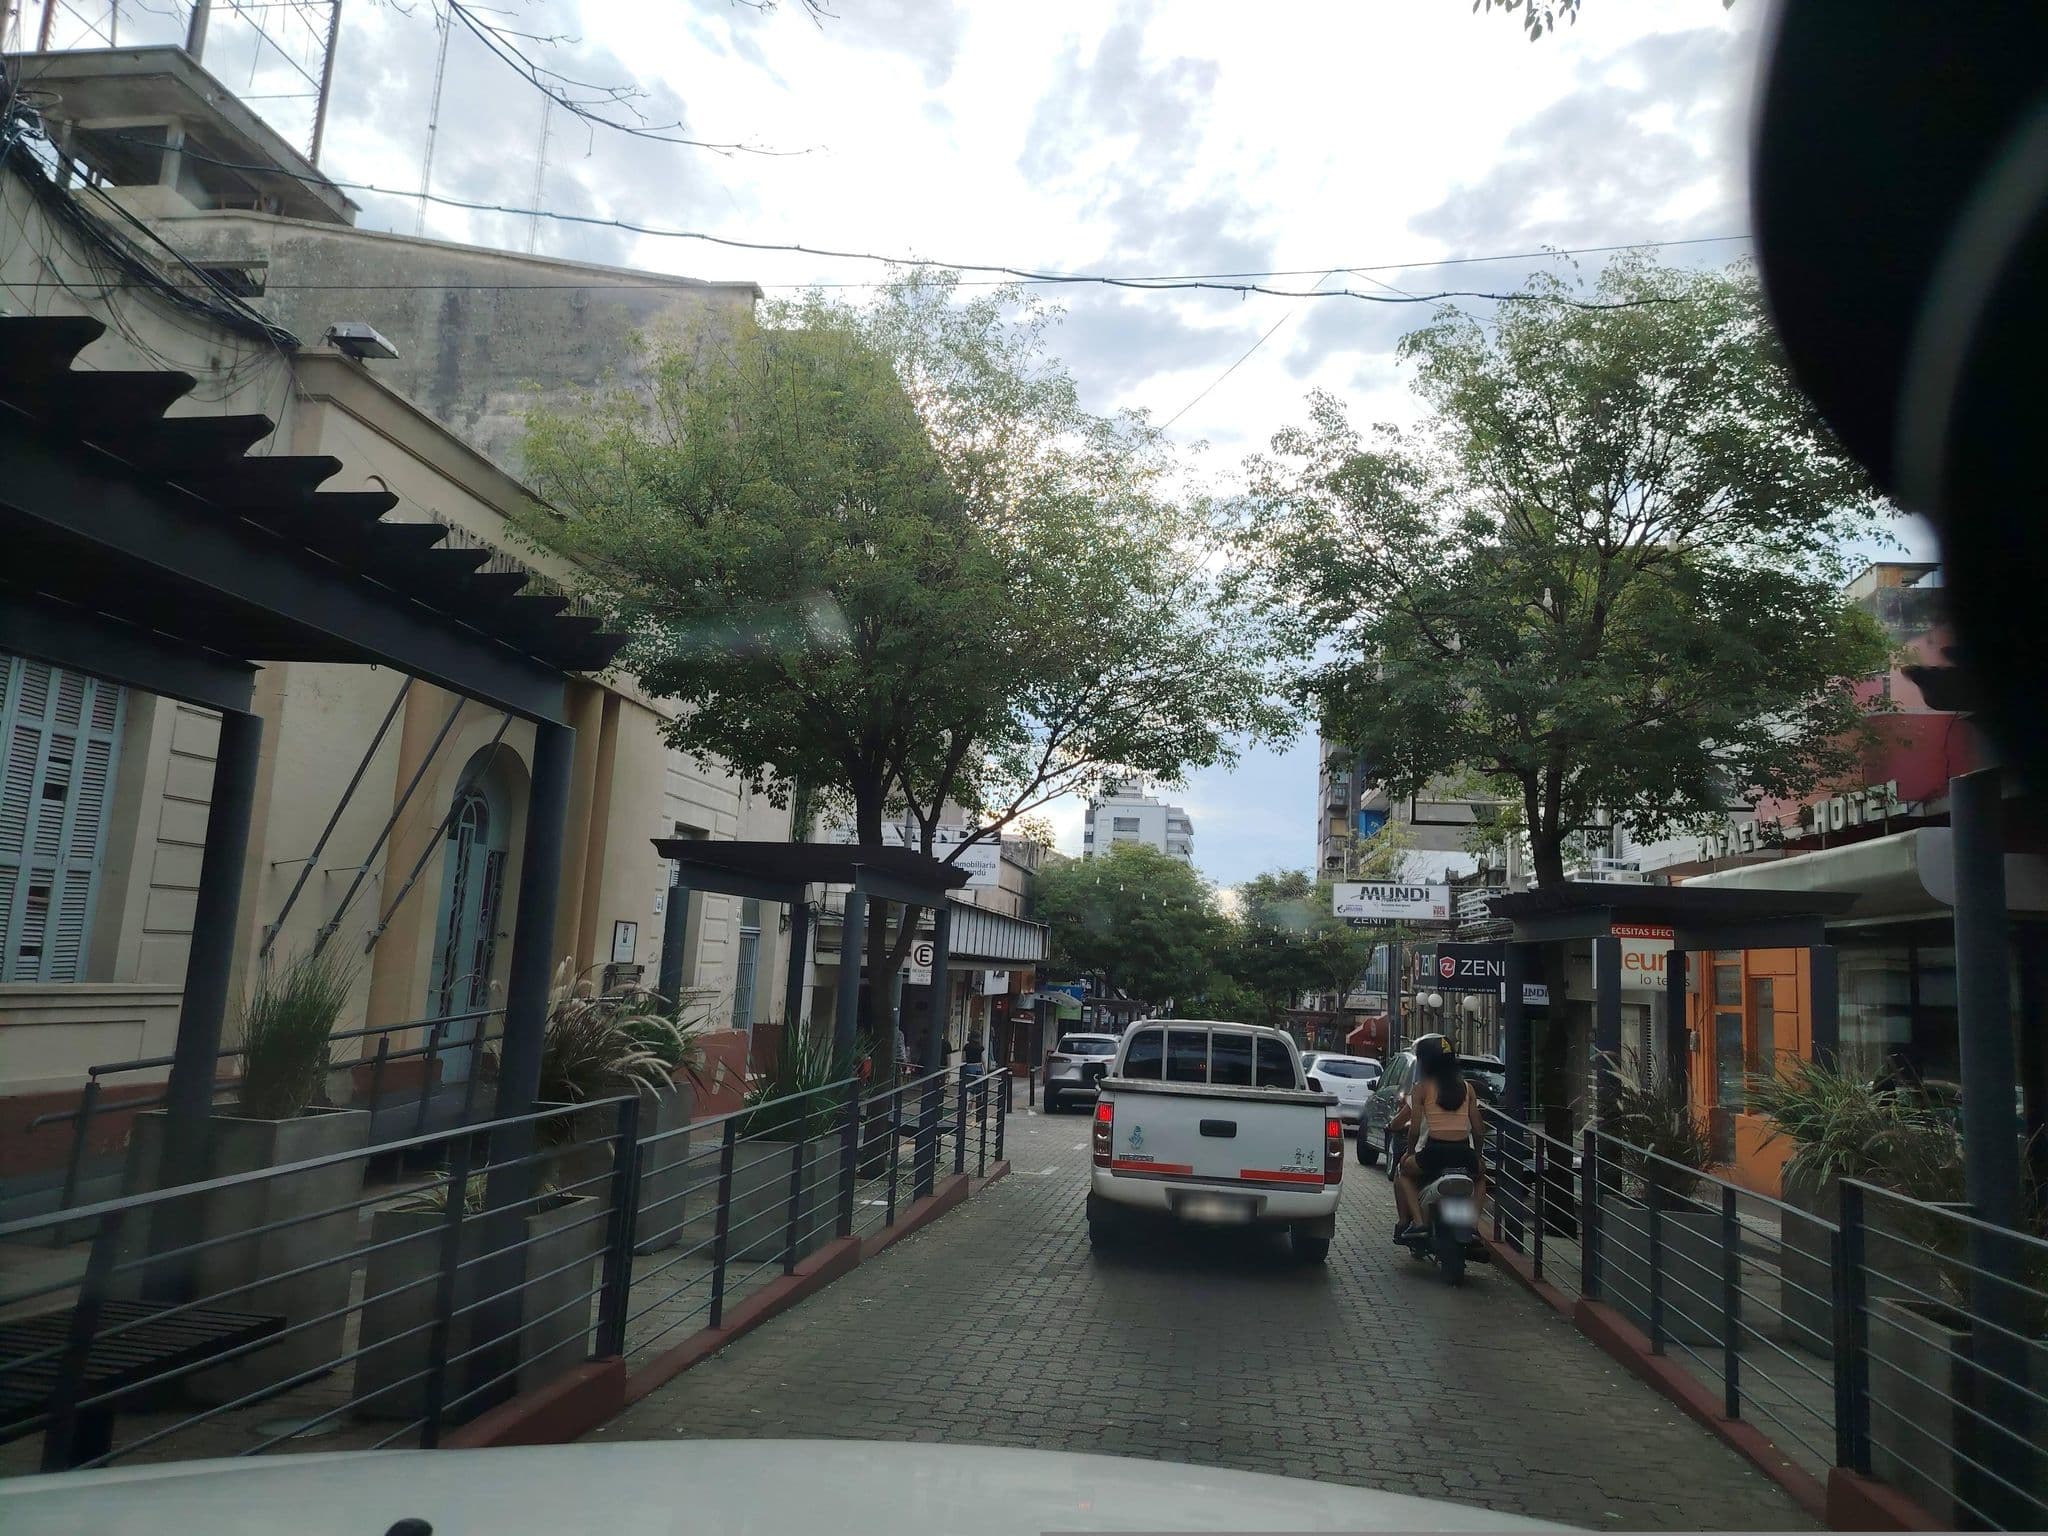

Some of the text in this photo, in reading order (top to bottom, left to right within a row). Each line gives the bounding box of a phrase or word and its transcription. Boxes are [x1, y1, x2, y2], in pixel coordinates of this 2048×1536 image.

[1813, 780, 1908, 835] HOTEL
[920, 948, 930, 962] E
[1640, 974, 1652, 985] lo
